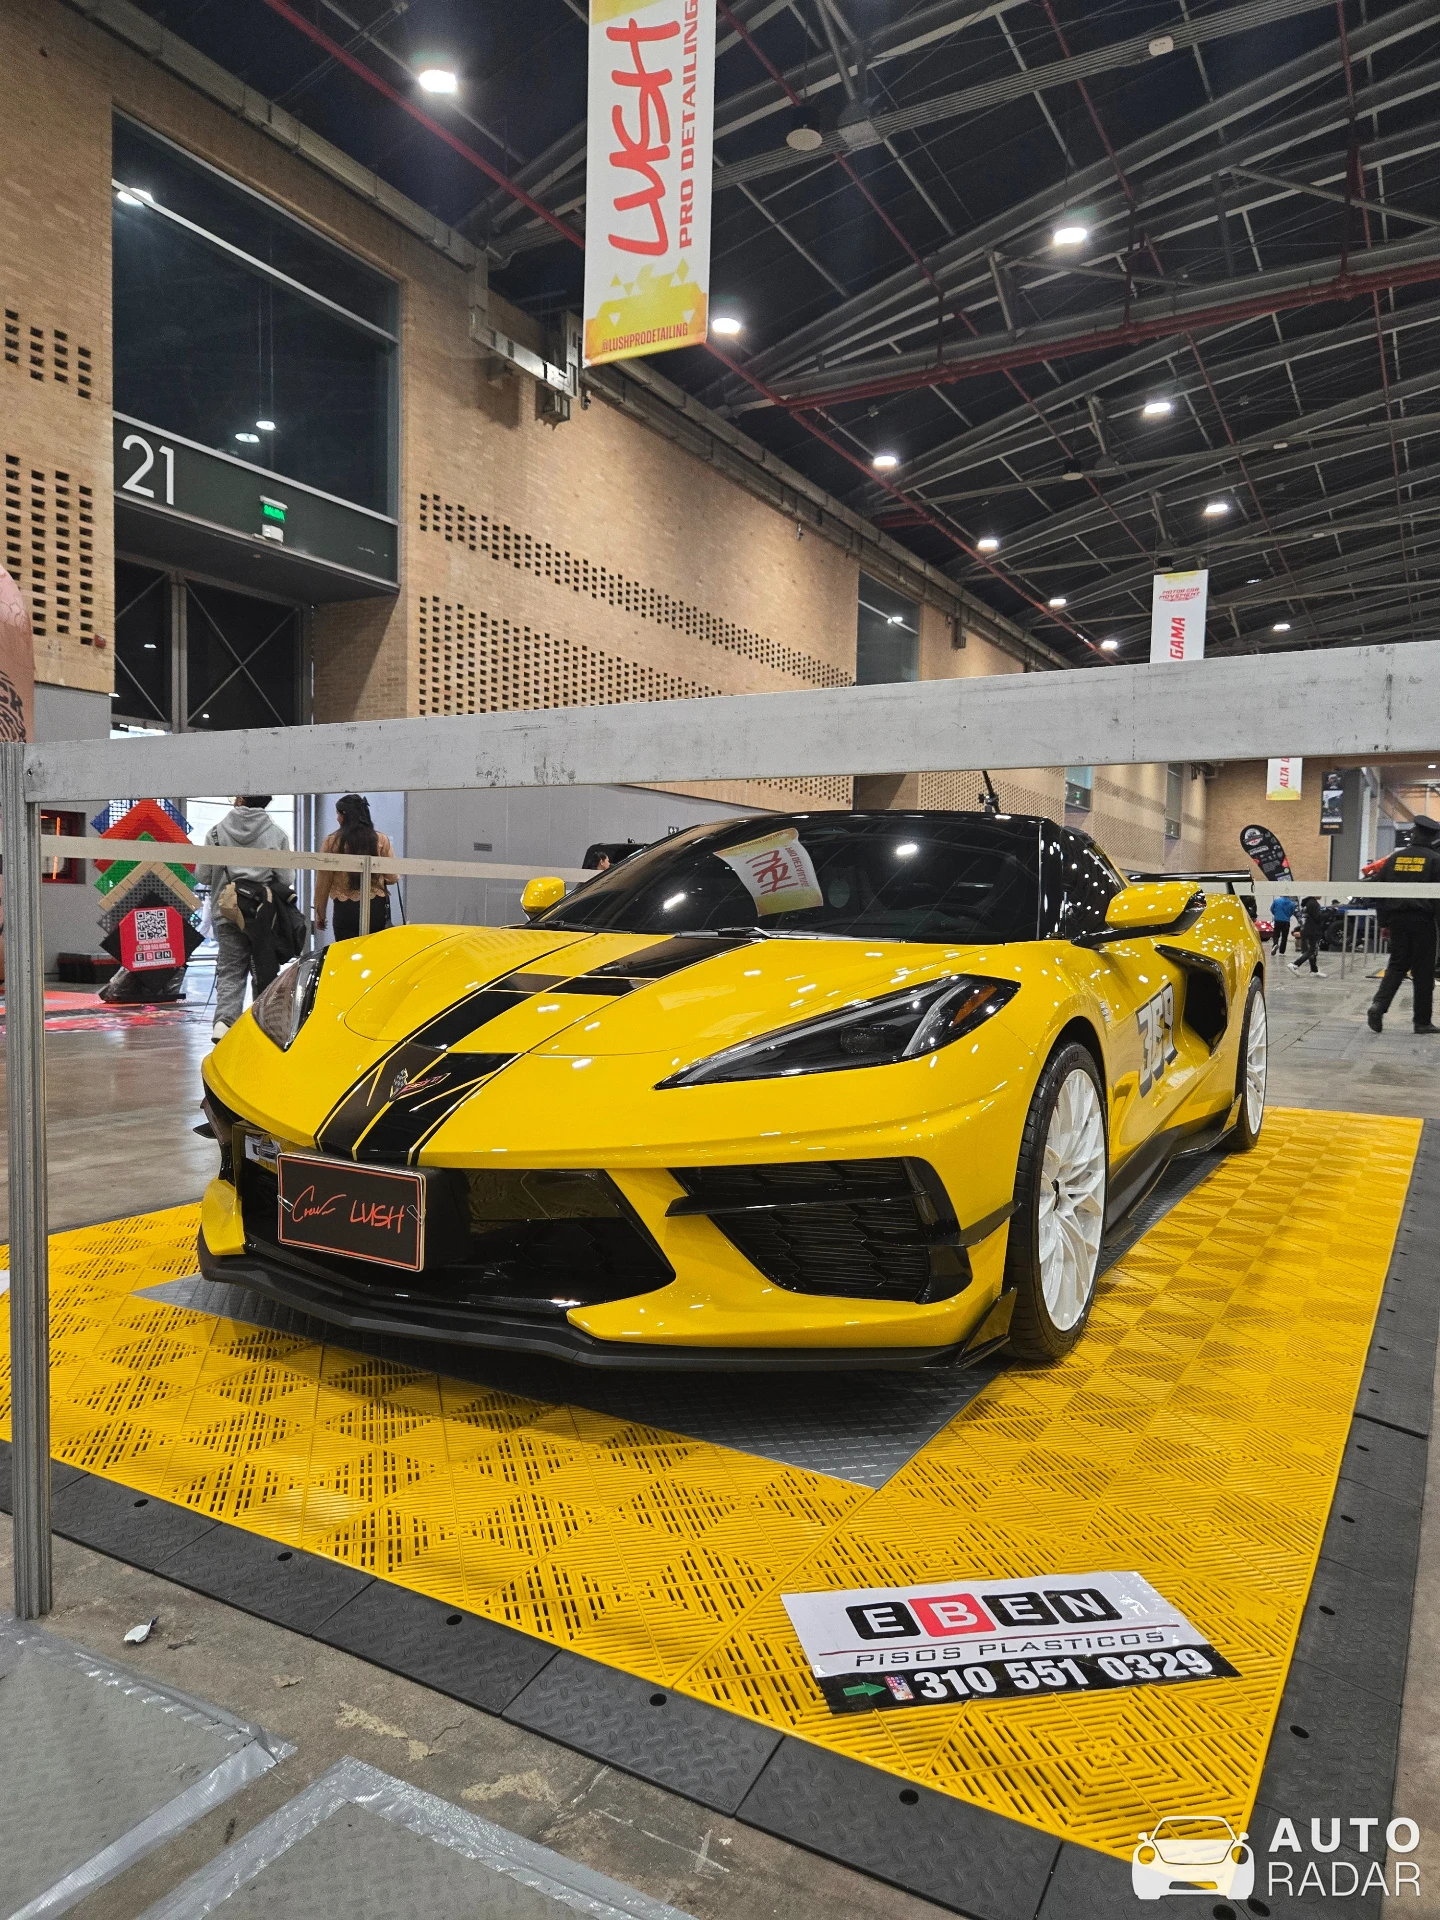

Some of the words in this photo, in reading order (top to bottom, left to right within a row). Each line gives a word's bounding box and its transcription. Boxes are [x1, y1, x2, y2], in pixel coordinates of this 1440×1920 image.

[681, 0, 699, 172] DETAILING
[606, 18, 680, 256] LUSH
[679, 177, 694, 249] PRO
[602, 322, 688, 352] @LUSHPRODETAILING
[122, 434, 174, 506] 21
[1170, 617, 1186, 660] GAMA
[1280, 767, 1289, 788] ALTA
[350, 1199, 405, 1234] LUSH
[860, 1591, 1111, 1636] EBEN
[856, 1646, 962, 1667] PISOS
[978, 1631, 1166, 1656] PLASTICOS
[914, 1666, 996, 1699] 310
[1005, 1659, 1089, 1690] 551
[1103, 1648, 1214, 1683] 0329
